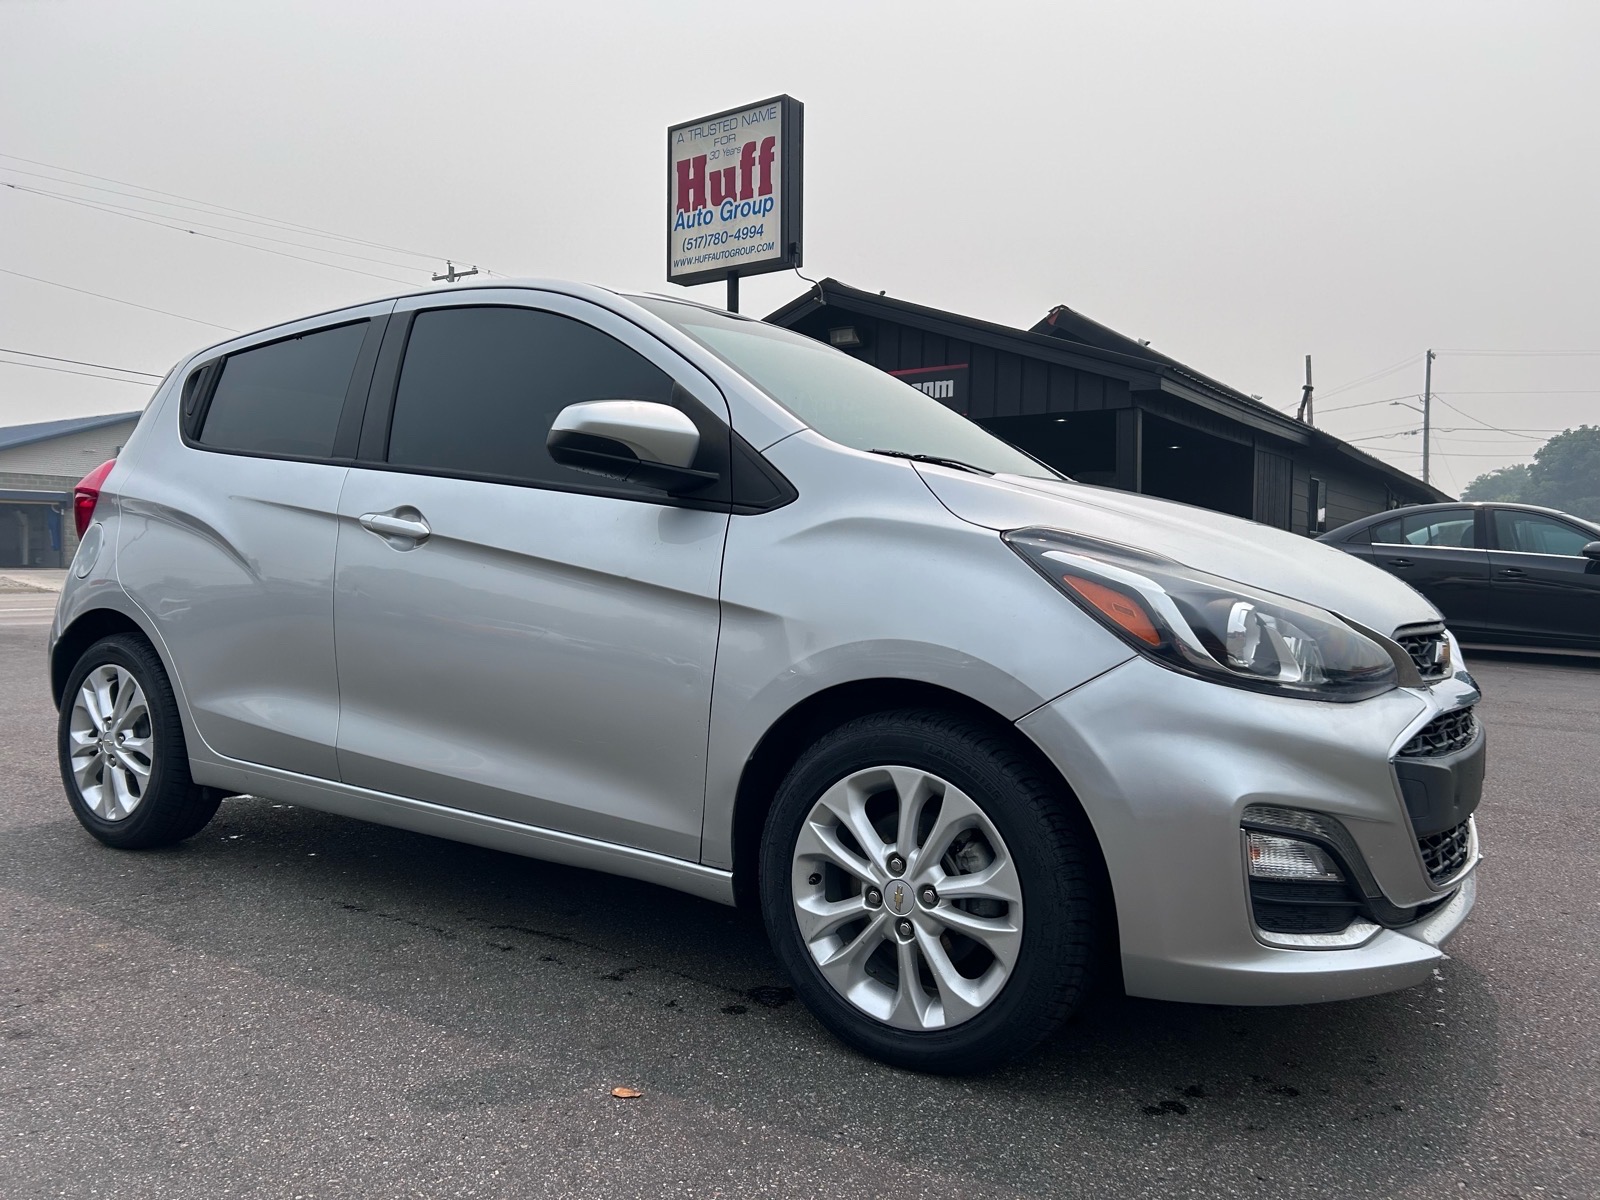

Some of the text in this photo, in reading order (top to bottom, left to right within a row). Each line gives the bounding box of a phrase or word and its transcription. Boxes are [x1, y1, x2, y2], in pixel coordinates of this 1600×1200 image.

[676, 107, 776, 145] A TRUSTED NAME
[714, 134, 736, 147] FOR
[709, 147, 741, 161] 30 Years
[677, 136, 775, 214] Huff
[673, 196, 774, 232] Auto Group
[682, 223, 764, 253] (517)780-4994
[674, 242, 774, 267] WWW.HUFFAUTOGROUP.COM
